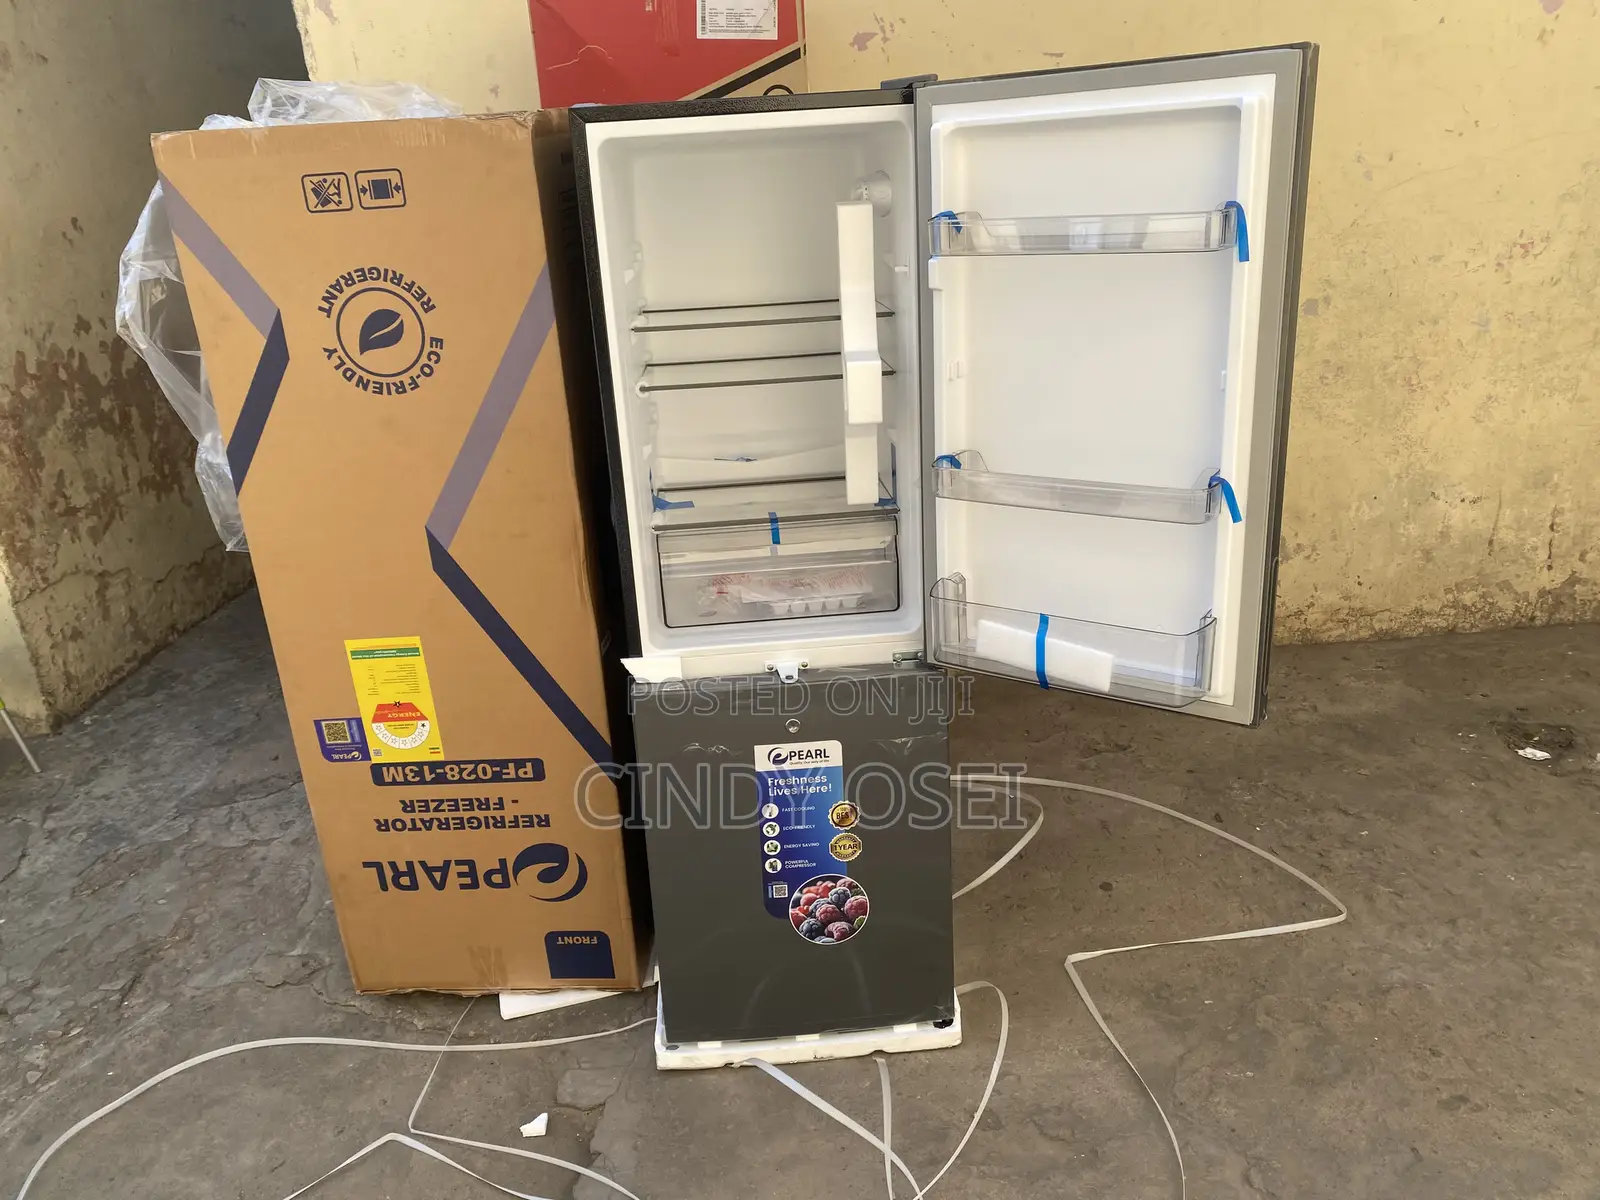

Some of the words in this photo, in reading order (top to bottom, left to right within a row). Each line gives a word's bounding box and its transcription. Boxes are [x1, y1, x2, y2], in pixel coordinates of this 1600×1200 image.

[317, 266, 437, 318] REFRIGERANT
[322, 336, 444, 396] ECO-FRIENDLY
[388, 711, 421, 719] ENERGY
[789, 748, 830, 761] PEARL
[381, 762, 534, 783] PF-028-13M
[768, 775, 827, 786] Freshness
[769, 786, 798, 796] Lives
[801, 783, 832, 794] Here!
[399, 797, 505, 813] FREEZER
[374, 814, 551, 832] REFRIGERATOR
[362, 858, 511, 892] PEARL
[556, 936, 598, 945] FRONT
